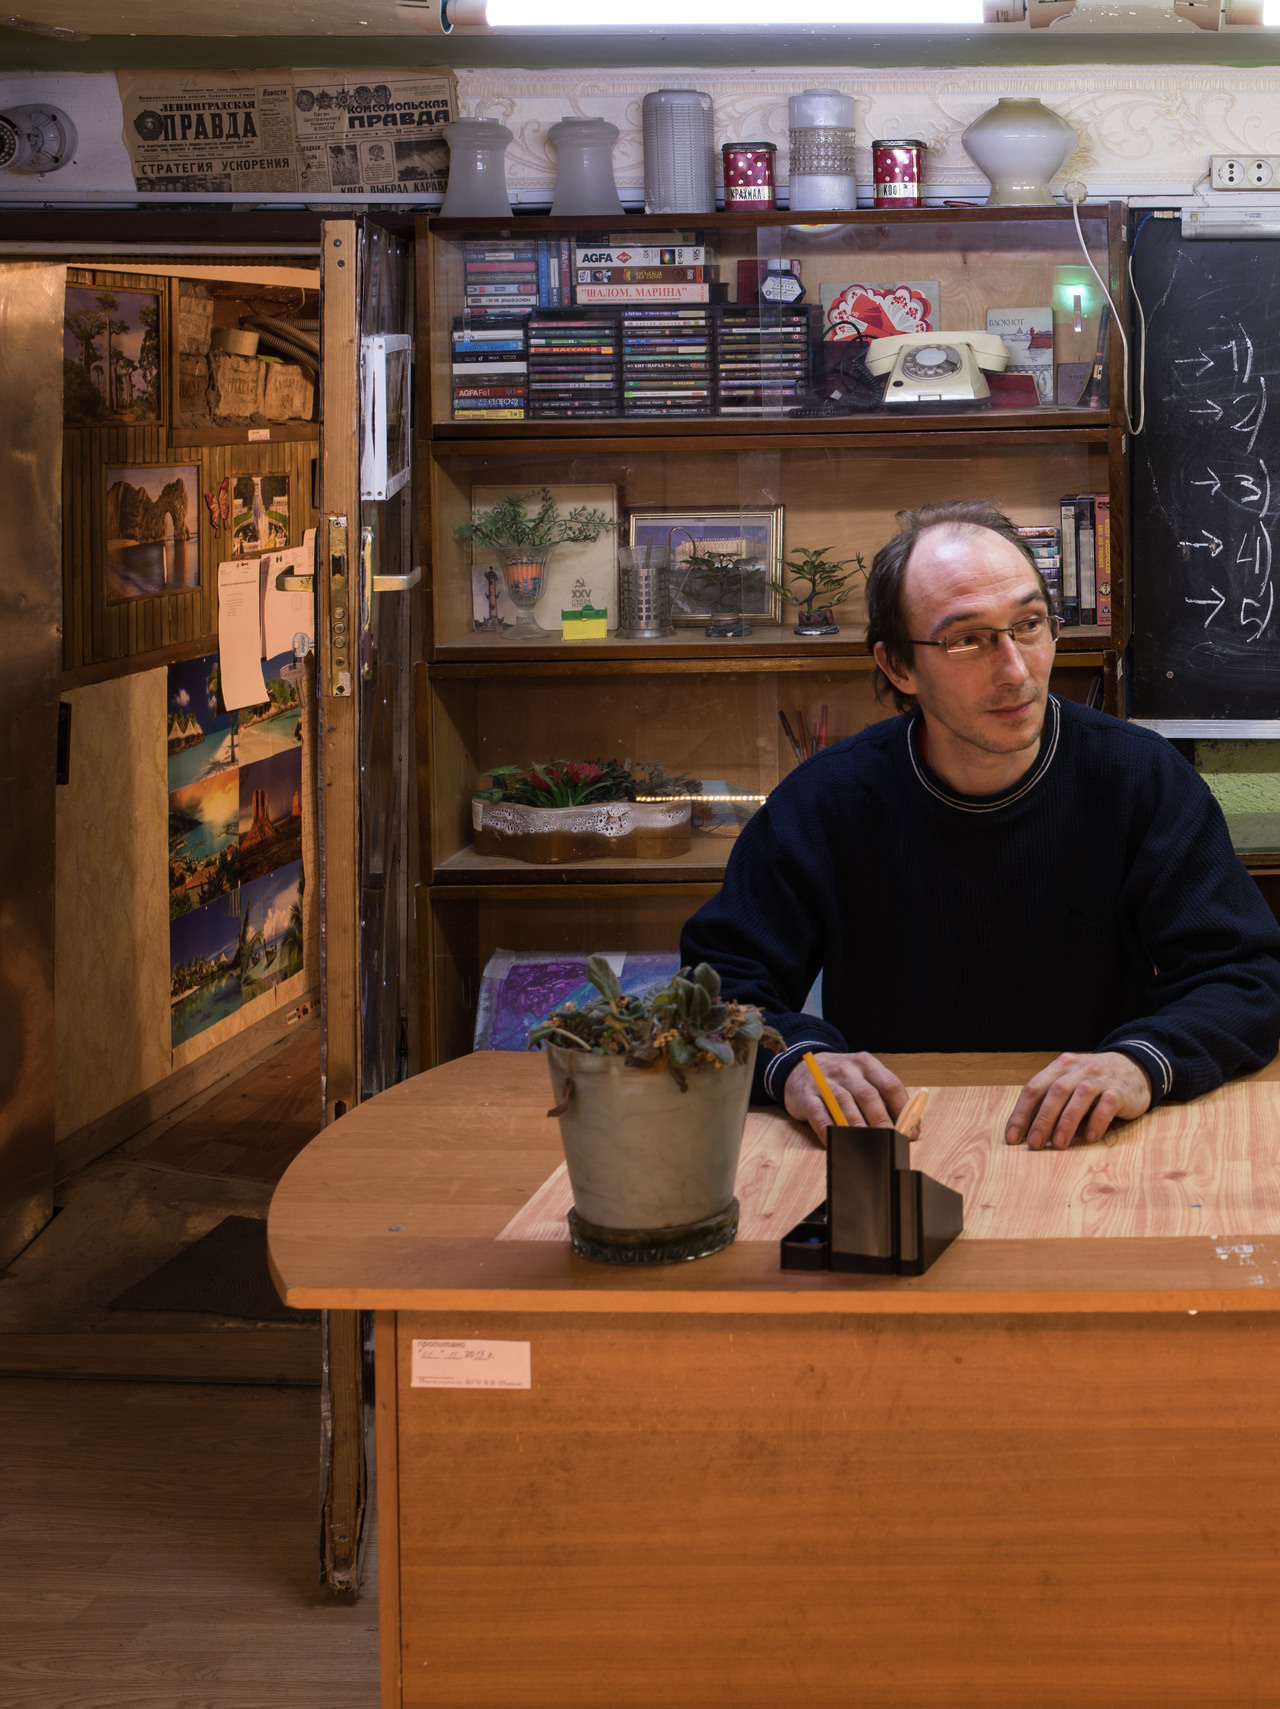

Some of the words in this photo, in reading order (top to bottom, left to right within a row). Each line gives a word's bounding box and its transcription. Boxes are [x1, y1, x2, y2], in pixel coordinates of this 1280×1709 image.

[160, 100, 256, 112] ЛЕНИНГРАДСКАЯ
[347, 99, 449, 114] КОМСОМОЛЬСКАЯ
[163, 111, 258, 141] ПРАВДА
[348, 109, 450, 129] ПРАВДА
[141, 161, 213, 175] СТРАТЕГИЯ
[222, 158, 290, 171] УСКОРЕНИЯ
[582, 253, 614, 264] AGFA
[988, 318, 1025, 327] БЛОКНОТ
